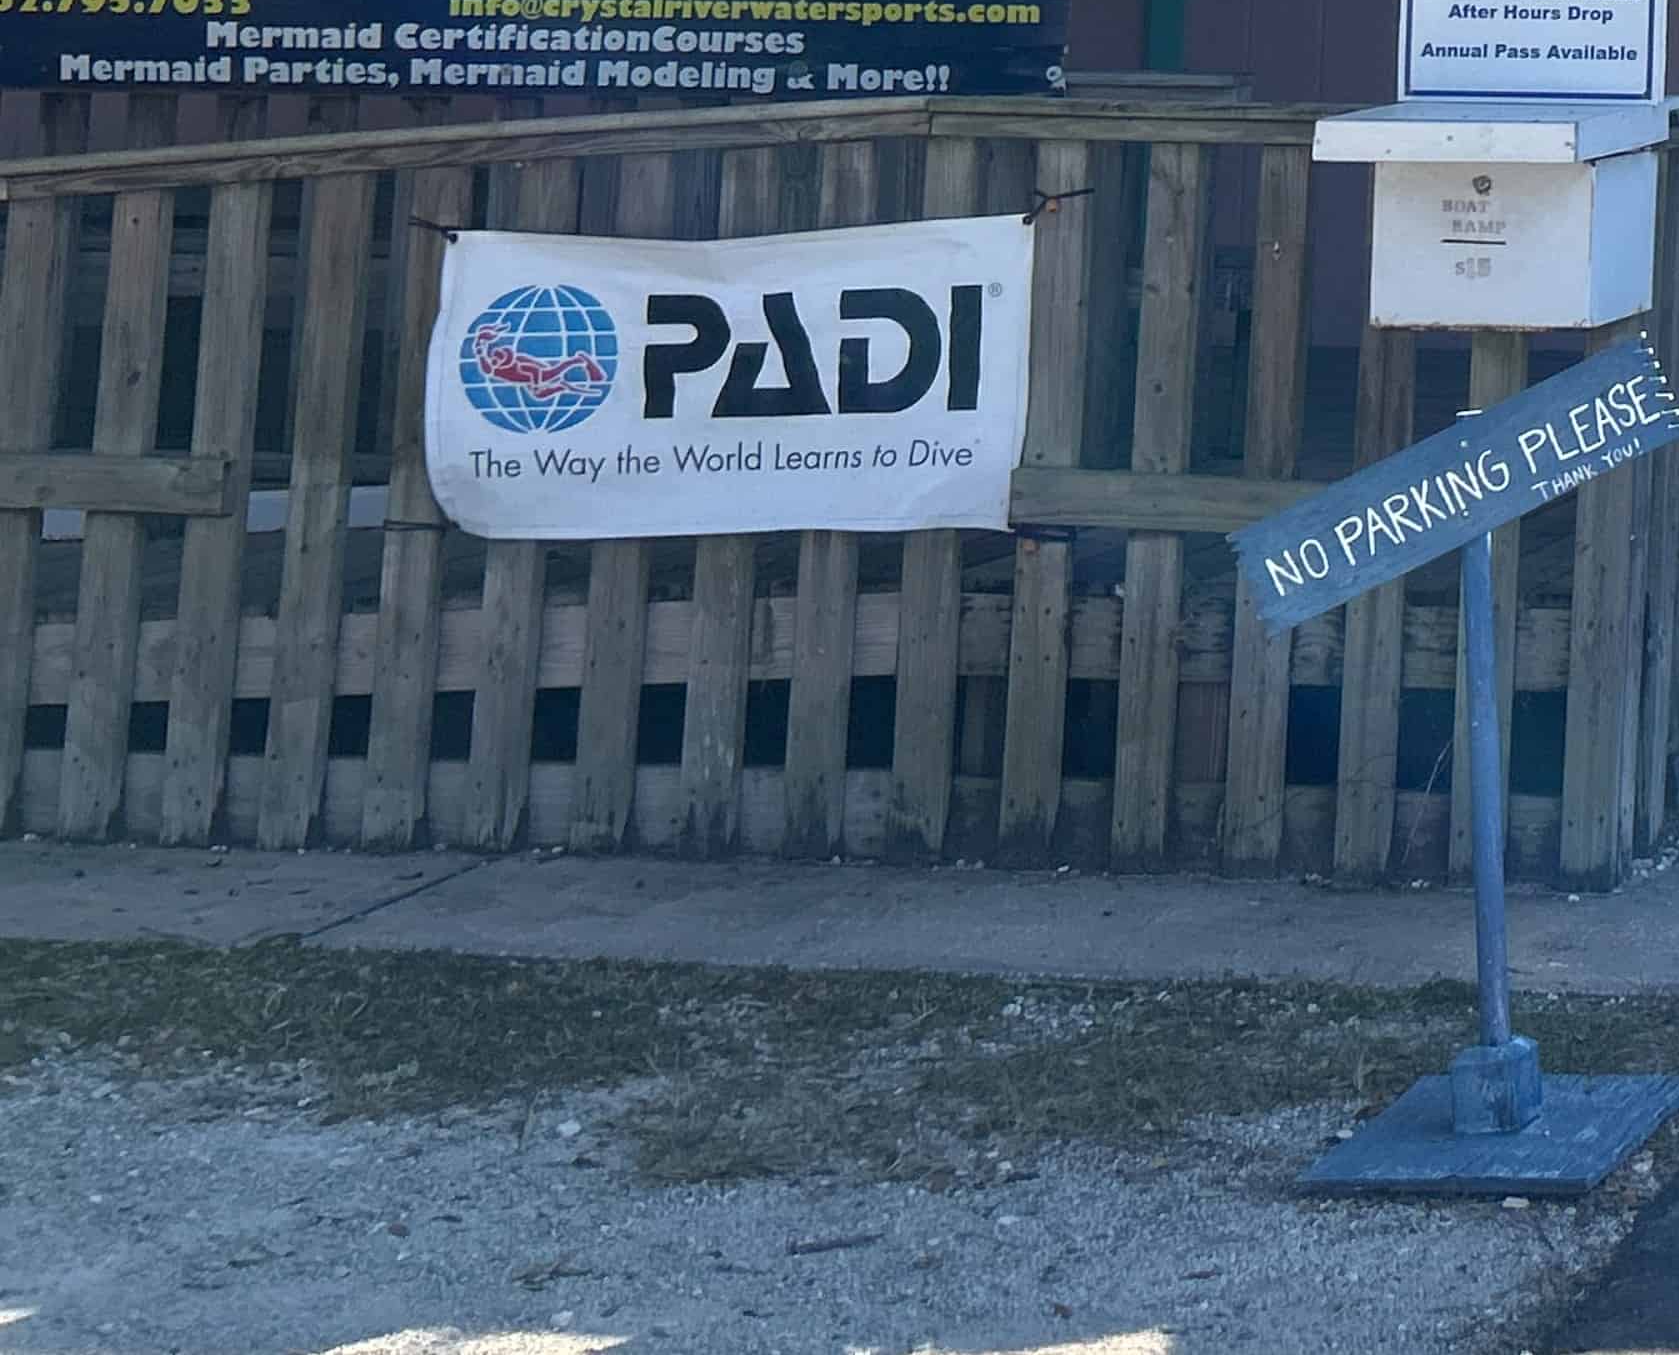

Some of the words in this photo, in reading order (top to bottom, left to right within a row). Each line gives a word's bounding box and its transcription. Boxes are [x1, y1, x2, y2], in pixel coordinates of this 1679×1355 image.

[1447, 3, 1498, 20] After
[1503, 4, 1561, 21] Hours
[1567, 5, 1614, 25] Drop
[205, 21, 382, 50] Mermaid
[394, 21, 806, 55] CertificationCourses
[1420, 42, 1489, 59] Annual
[1494, 43, 1541, 60] Pass
[1545, 44, 1639, 62] Available
[59, 54, 232, 84] Mermaid
[243, 56, 400, 89] Parties,
[409, 58, 587, 87] Mermaid
[596, 59, 777, 94] Modeling
[787, 66, 815, 90] &
[826, 62, 951, 93] More!!
[643, 284, 984, 420] PADI
[469, 449, 523, 480] The
[532, 447, 607, 485] Way
[616, 444, 662, 476] the
[671, 442, 763, 473] World
[774, 443, 863, 471] Learns
[871, 443, 899, 469] to
[908, 439, 975, 469] Dive
[1530, 463, 1601, 503] THANK
[1600, 437, 1646, 468] YOU!
[1264, 539, 1330, 598] NO
[1333, 449, 1512, 567] PARKING
[1516, 375, 1667, 476] PLEASE
